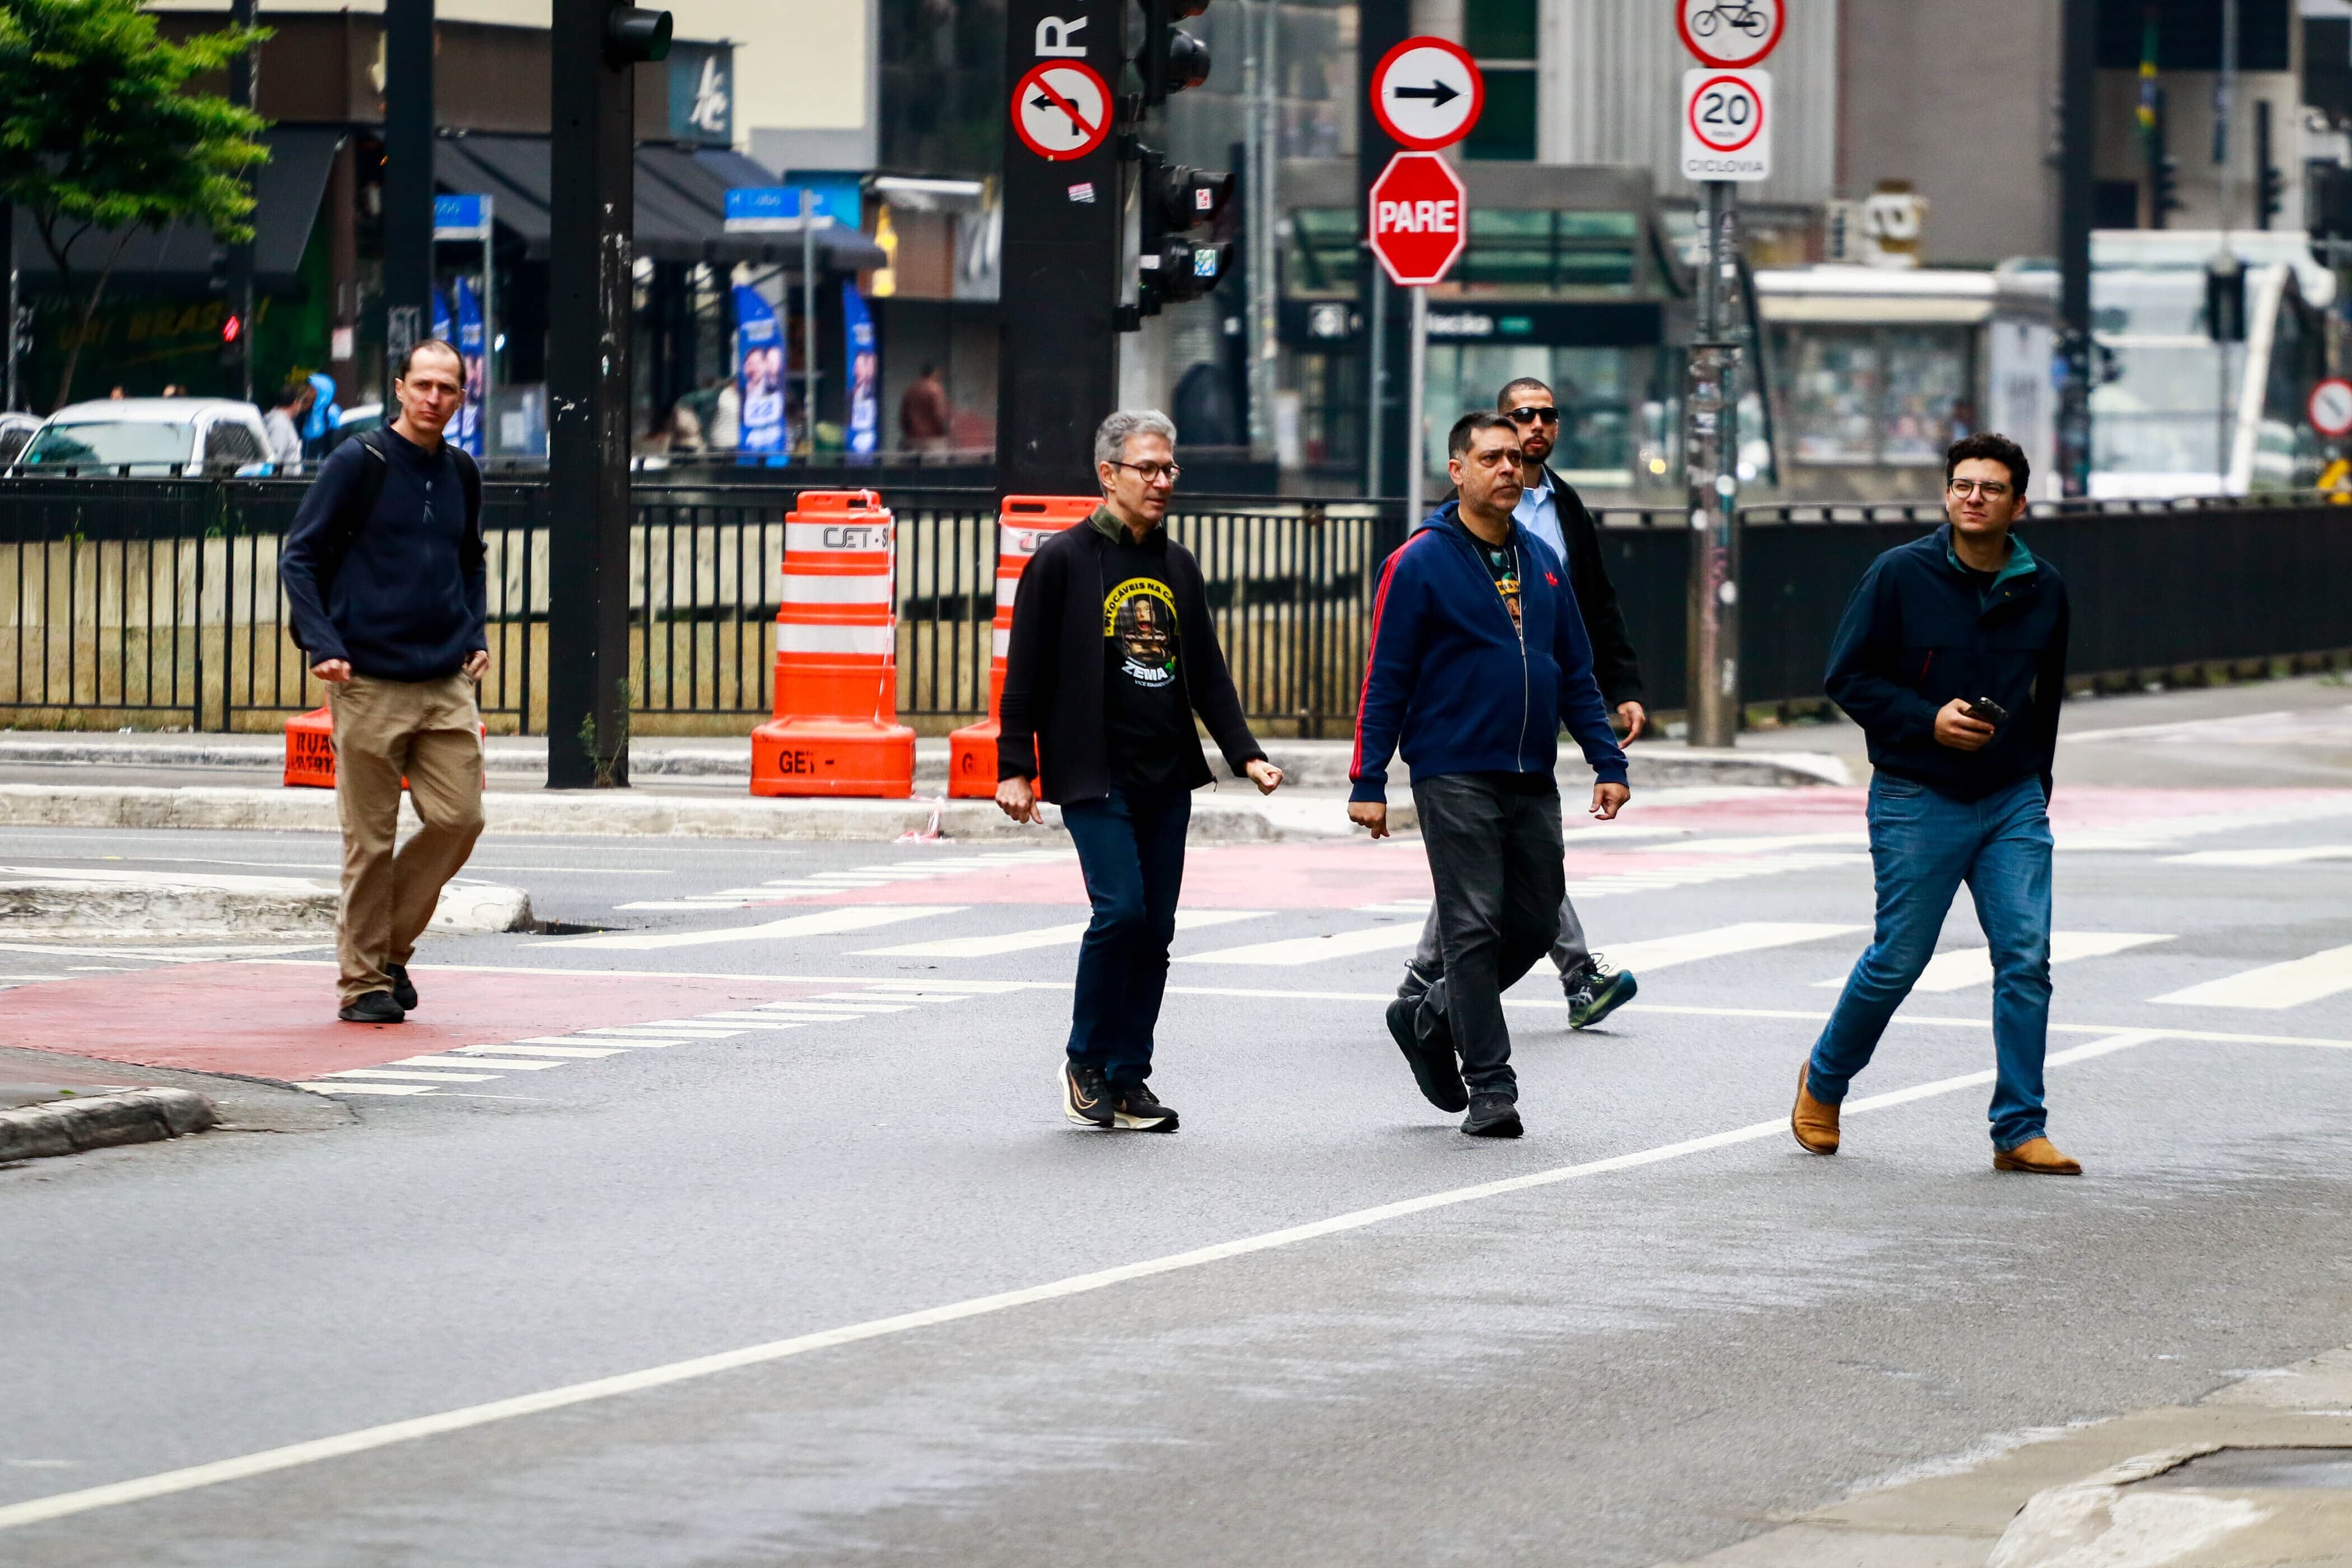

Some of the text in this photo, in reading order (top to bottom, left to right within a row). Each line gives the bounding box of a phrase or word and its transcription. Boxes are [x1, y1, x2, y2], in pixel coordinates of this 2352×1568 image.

[1703, 92, 1750, 125] 20
[1687, 159, 1763, 172] CICLOVIA
[1378, 200, 1456, 233] PARE
[1121, 660, 1168, 681] ZEMA
[296, 733, 330, 753] RUA
